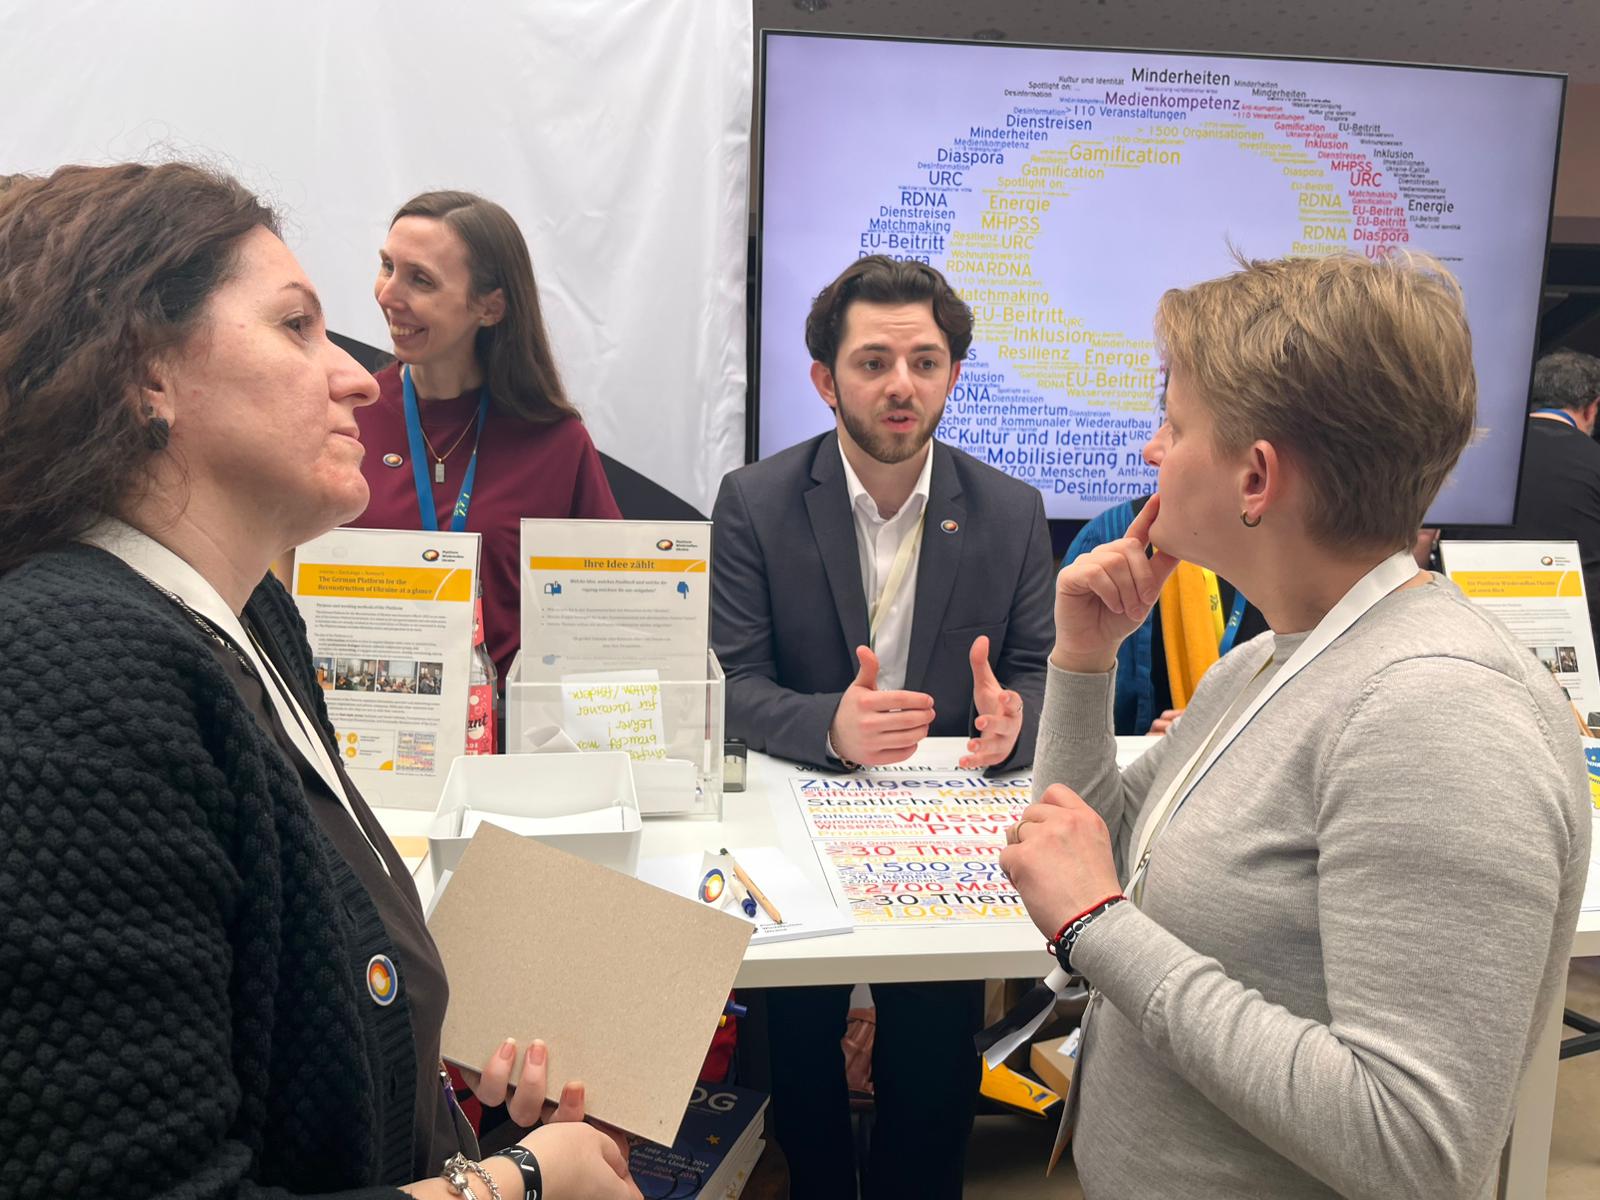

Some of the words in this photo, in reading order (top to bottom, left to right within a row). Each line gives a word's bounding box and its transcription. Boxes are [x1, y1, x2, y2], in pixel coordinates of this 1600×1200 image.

[1132, 67, 1230, 86] Minderheiten
[1028, 81, 1060, 90] Spotlight
[1004, 89, 1052, 98] Desinformation
[1252, 88, 1306, 98] Minderheiten
[1105, 91, 1240, 111] Medienkompetenz
[1100, 106, 1186, 120] Veranstaltungen
[1006, 114, 1092, 130] Dienstreisen
[1274, 122, 1326, 132] Gamification
[1338, 123, 1381, 132] EU-Beitritt
[970, 126, 1048, 141] Minderheiten
[1183, 128, 1264, 140] Organisationen
[954, 138, 1030, 150] Medienkompetenz
[1304, 140, 1348, 150] Inklusion
[938, 148, 1004, 166] Diaspora
[1070, 144, 1182, 164] Gamification
[1318, 150, 1366, 160] Dienstreisen
[1374, 149, 1414, 160] Inklusion
[1022, 164, 1104, 180] Gamification
[1331, 160, 1372, 172] MHPSS
[929, 170, 963, 186] URC
[998, 177, 1046, 190] Spotlight
[1350, 172, 1382, 188] URC
[901, 191, 948, 207] RDNA
[989, 194, 1050, 214] Energie
[1298, 192, 1342, 208] RDNA
[880, 206, 956, 220] Dienstreisen
[1352, 205, 1404, 216] EU-Beitritt
[1408, 200, 1454, 214] Energie
[870, 218, 950, 234] Matchmaking
[981, 215, 1041, 232] MHPSS
[1356, 216, 1406, 226] EU-Beitritt
[1304, 225, 1348, 240] RDNA
[1354, 229, 1410, 244] Diaspora
[861, 233, 944, 250] EU-Beitritt
[1002, 234, 1034, 250] URC
[946, 260, 984, 272] RDNA
[987, 261, 1032, 276] RDNA
[972, 305, 1066, 324] EU-Beitritt
[1063, 318, 1085, 328] URC
[1014, 326, 1092, 344] Inklusion
[998, 345, 1070, 360] Resilienz
[1085, 348, 1150, 368] Energie
[960, 371, 1004, 382] nklusion
[1066, 372, 1156, 389] EU-Beitritt
[992, 394, 1044, 404] Dienstreisen
[957, 402, 1068, 418] Unternehmertum
[976, 416, 998, 426] und
[1001, 416, 1071, 428] kommunaler
[1076, 418, 1152, 429] Wiederaufbau
[934, 426, 957, 440] RC
[958, 428, 1010, 444] Kultur
[1016, 430, 1048, 445] und
[1056, 430, 1128, 446] Identität
[1129, 430, 1152, 440] URC
[988, 447, 1118, 470] Mobilisierung
[1041, 466, 1106, 478] Menschen
[1117, 467, 1159, 478] Anti-Kor
[1054, 479, 1158, 495] Desinformat
[584, 560, 604, 568] Ihre
[607, 560, 628, 568] Idee
[630, 560, 655, 569] zählt
[799, 778, 1032, 790] Zivilgesellsc
[808, 798, 944, 806] Staatliche
[926, 823, 1010, 834] Priv
[908, 845, 1003, 856] Them
[930, 894, 1022, 905] Them
